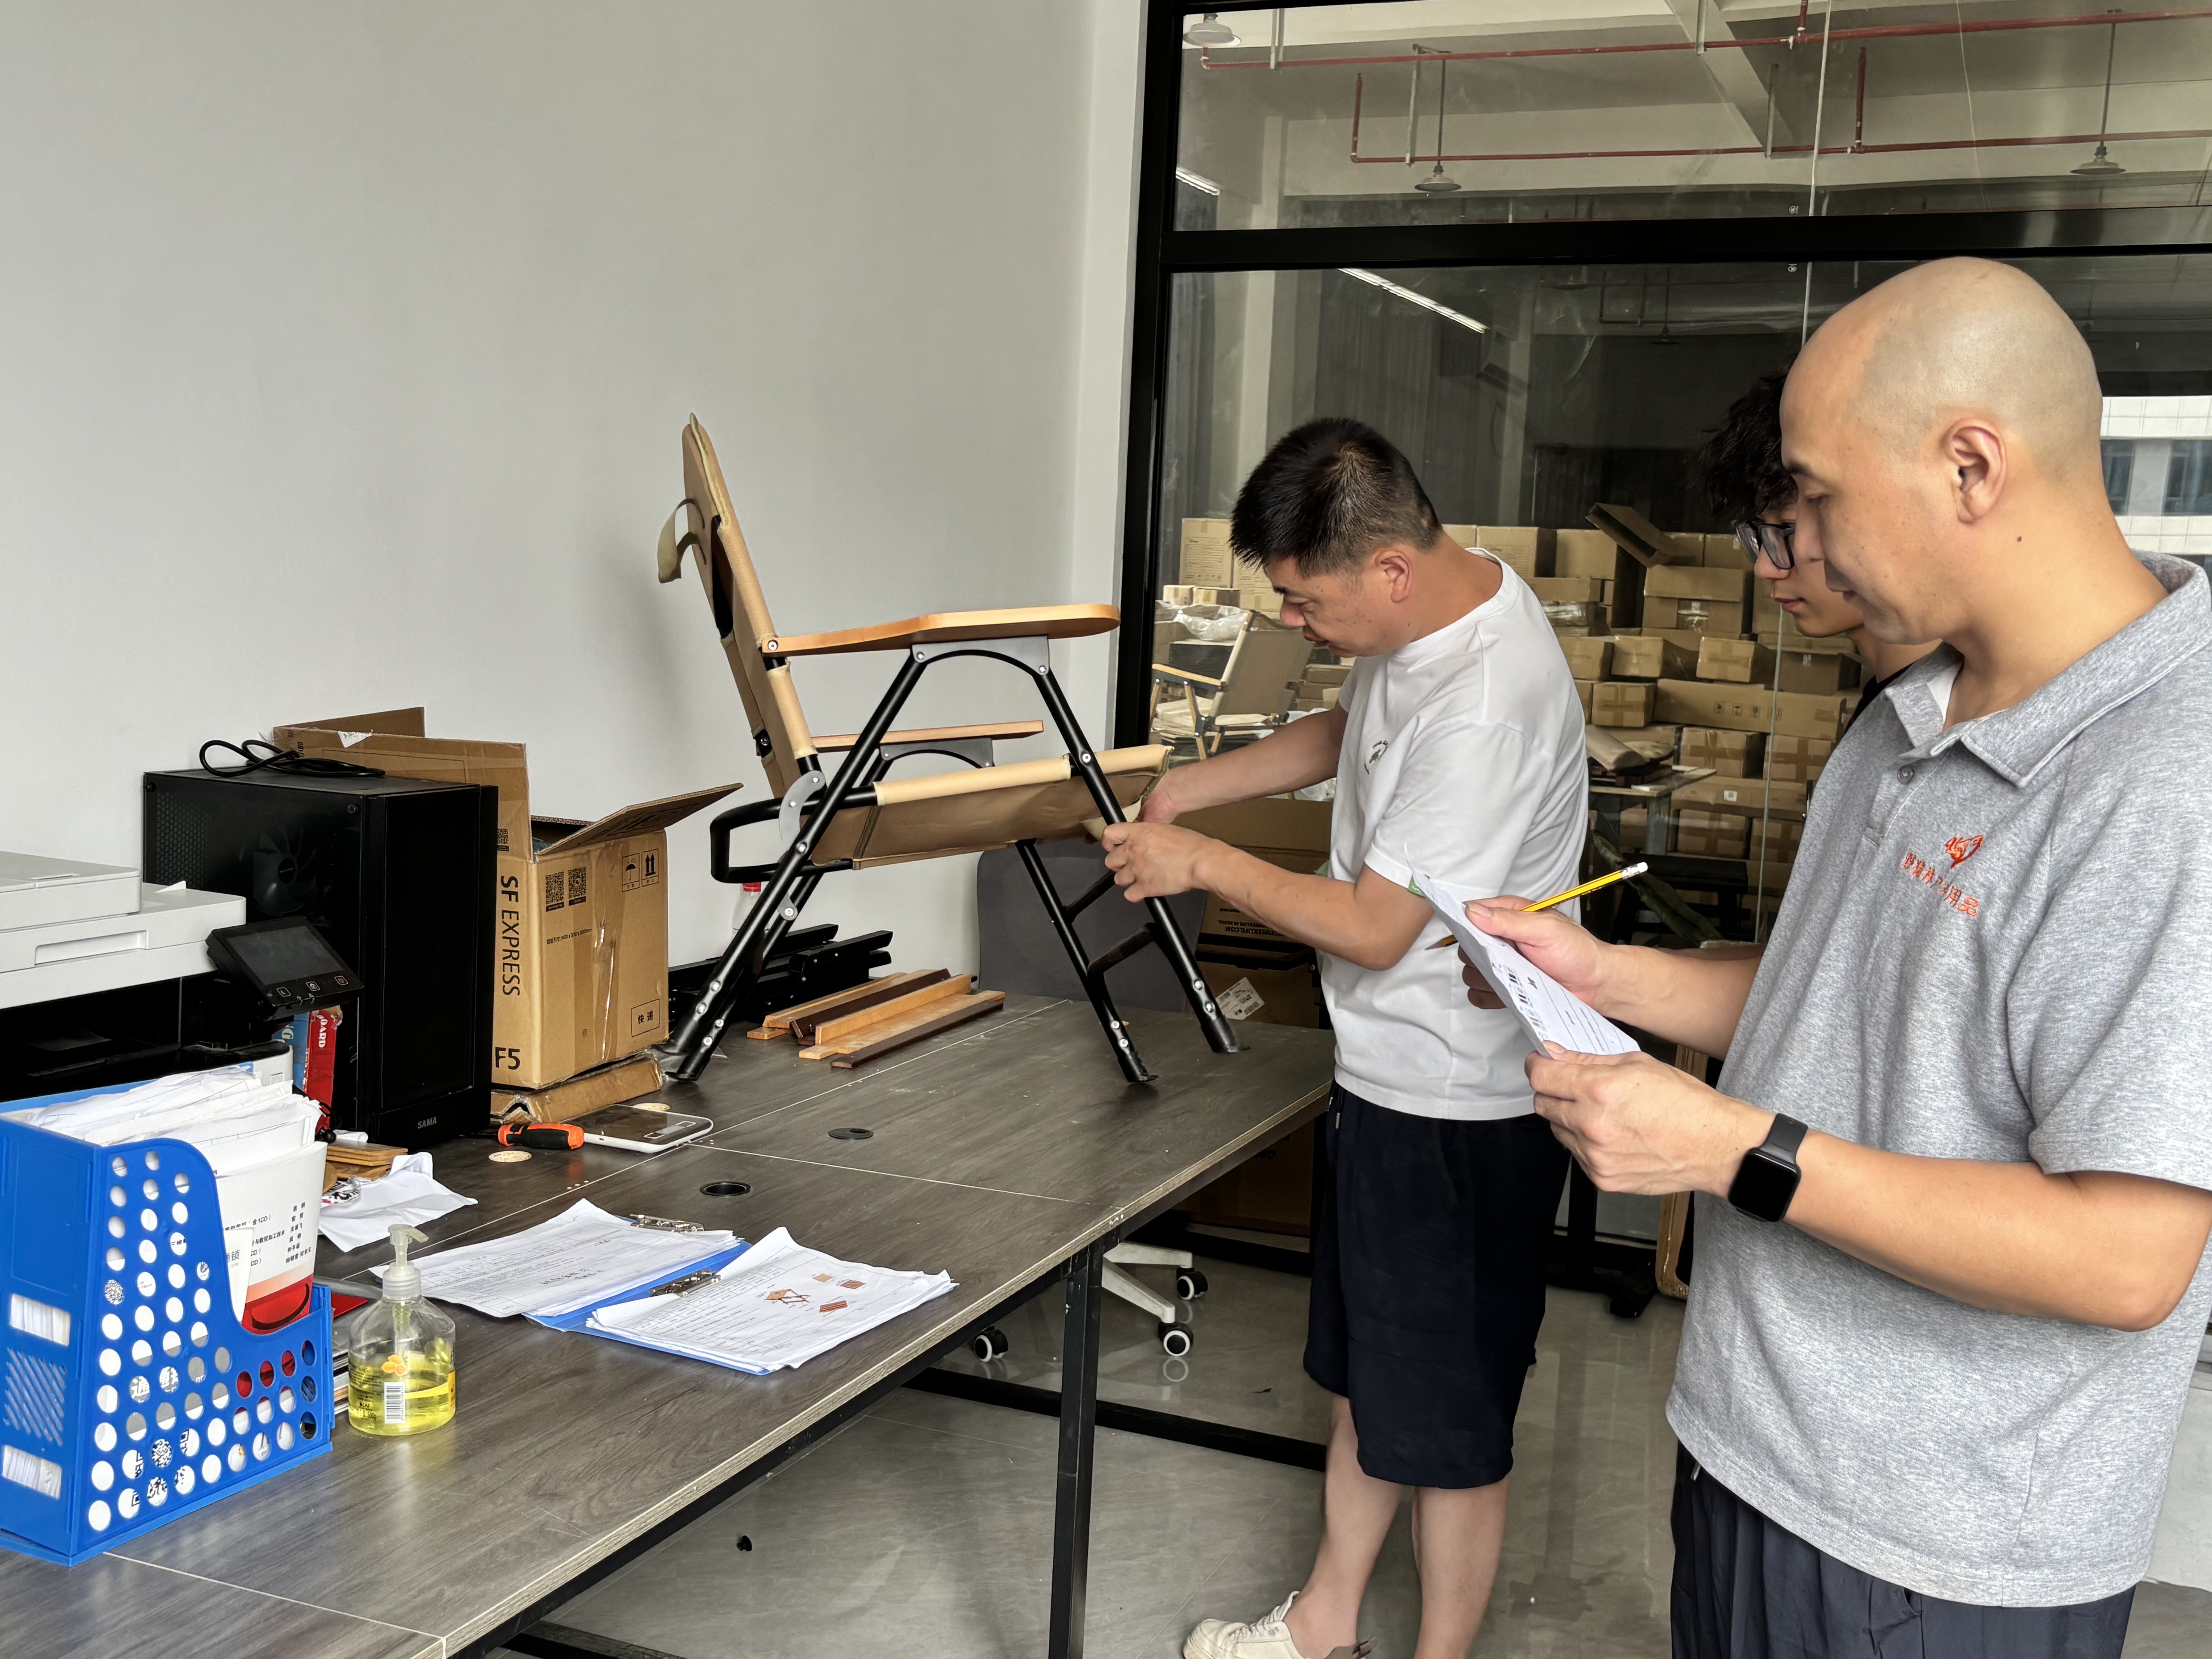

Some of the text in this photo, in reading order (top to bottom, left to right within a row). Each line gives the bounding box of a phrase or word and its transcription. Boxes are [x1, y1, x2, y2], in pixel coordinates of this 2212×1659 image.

[501, 875, 520, 996] SF EXPRESS
[495, 1047, 520, 1070] F5
[417, 1116, 437, 1129] SAMA
